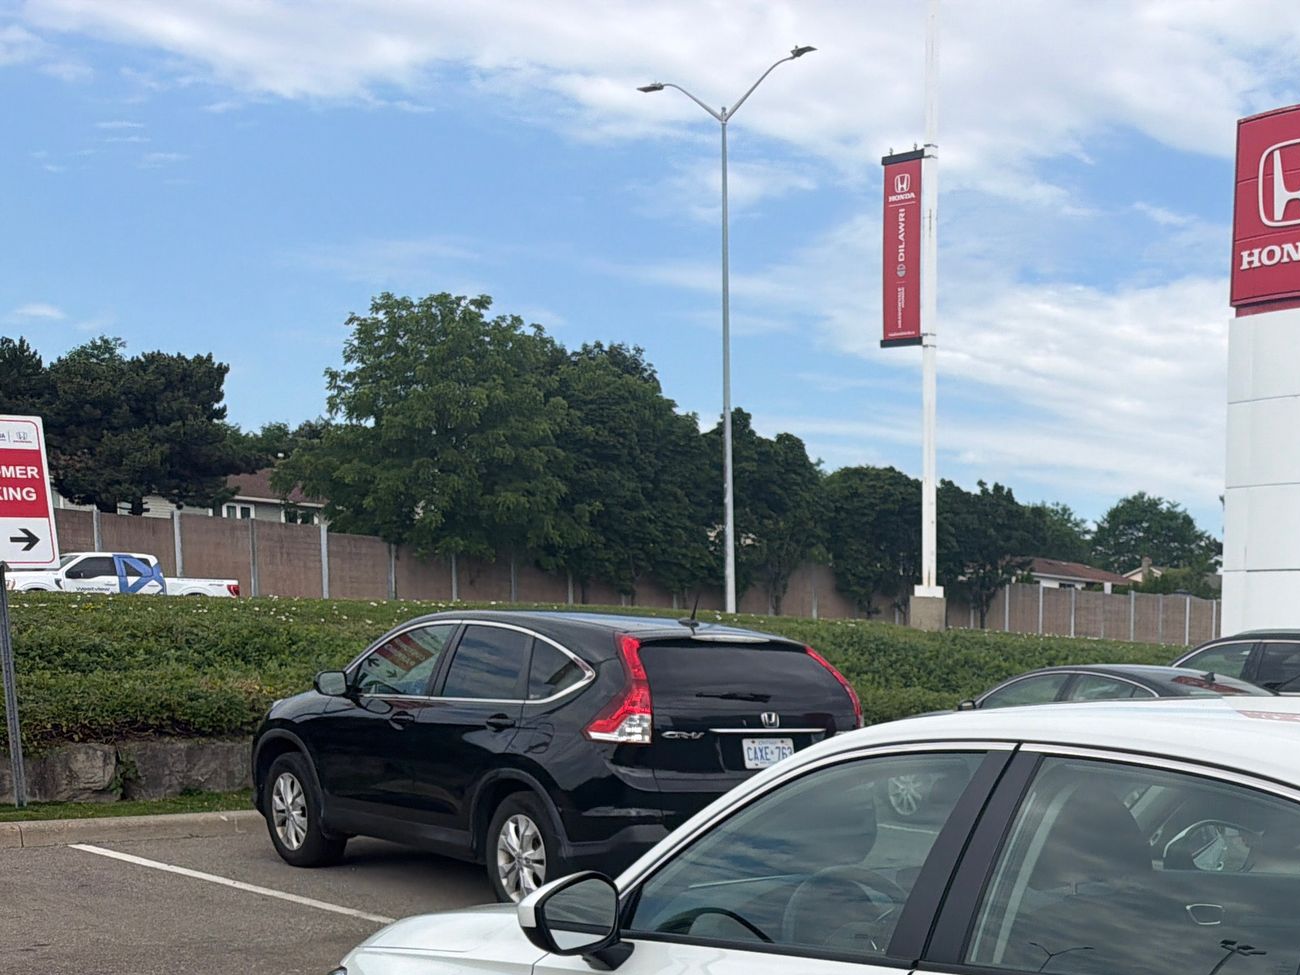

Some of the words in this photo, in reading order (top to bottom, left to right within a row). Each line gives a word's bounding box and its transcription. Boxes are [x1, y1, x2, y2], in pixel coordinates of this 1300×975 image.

[888, 192, 916, 203] HONDA
[898, 208, 906, 262] DILAWRI
[0, 465, 40, 479] MER
[746, 745, 771, 761] CAXE
